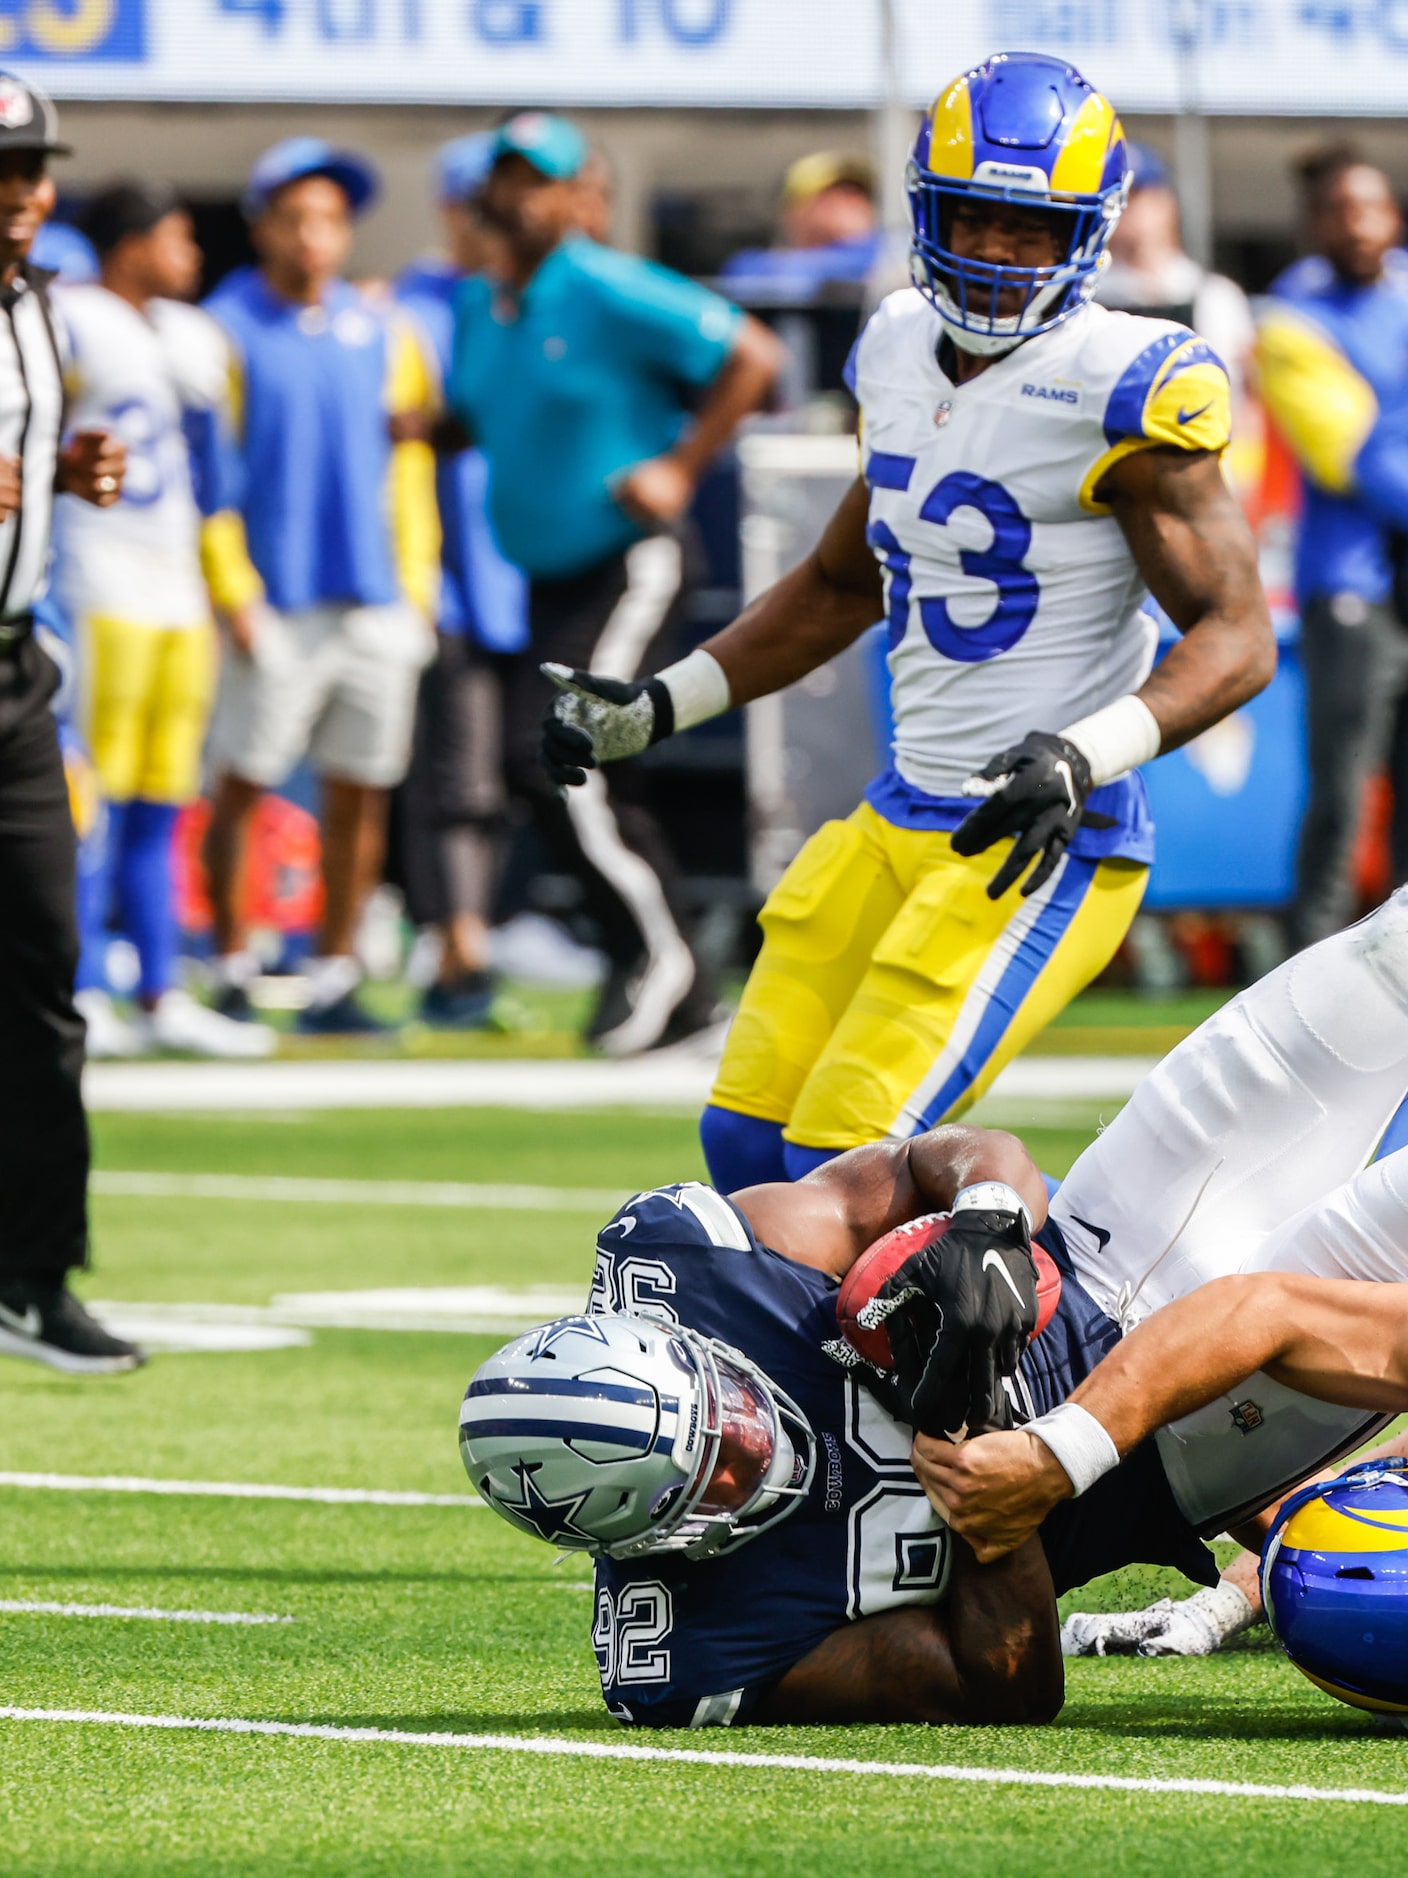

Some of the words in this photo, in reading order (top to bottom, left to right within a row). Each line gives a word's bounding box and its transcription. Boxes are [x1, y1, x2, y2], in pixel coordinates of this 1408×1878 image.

[1021, 383, 1079, 404] RAMS
[865, 449, 1041, 663] 53
[685, 1402, 698, 1452] COWBOYS
[821, 1431, 843, 1512] COWBOYS
[591, 1580, 673, 1690] 92
